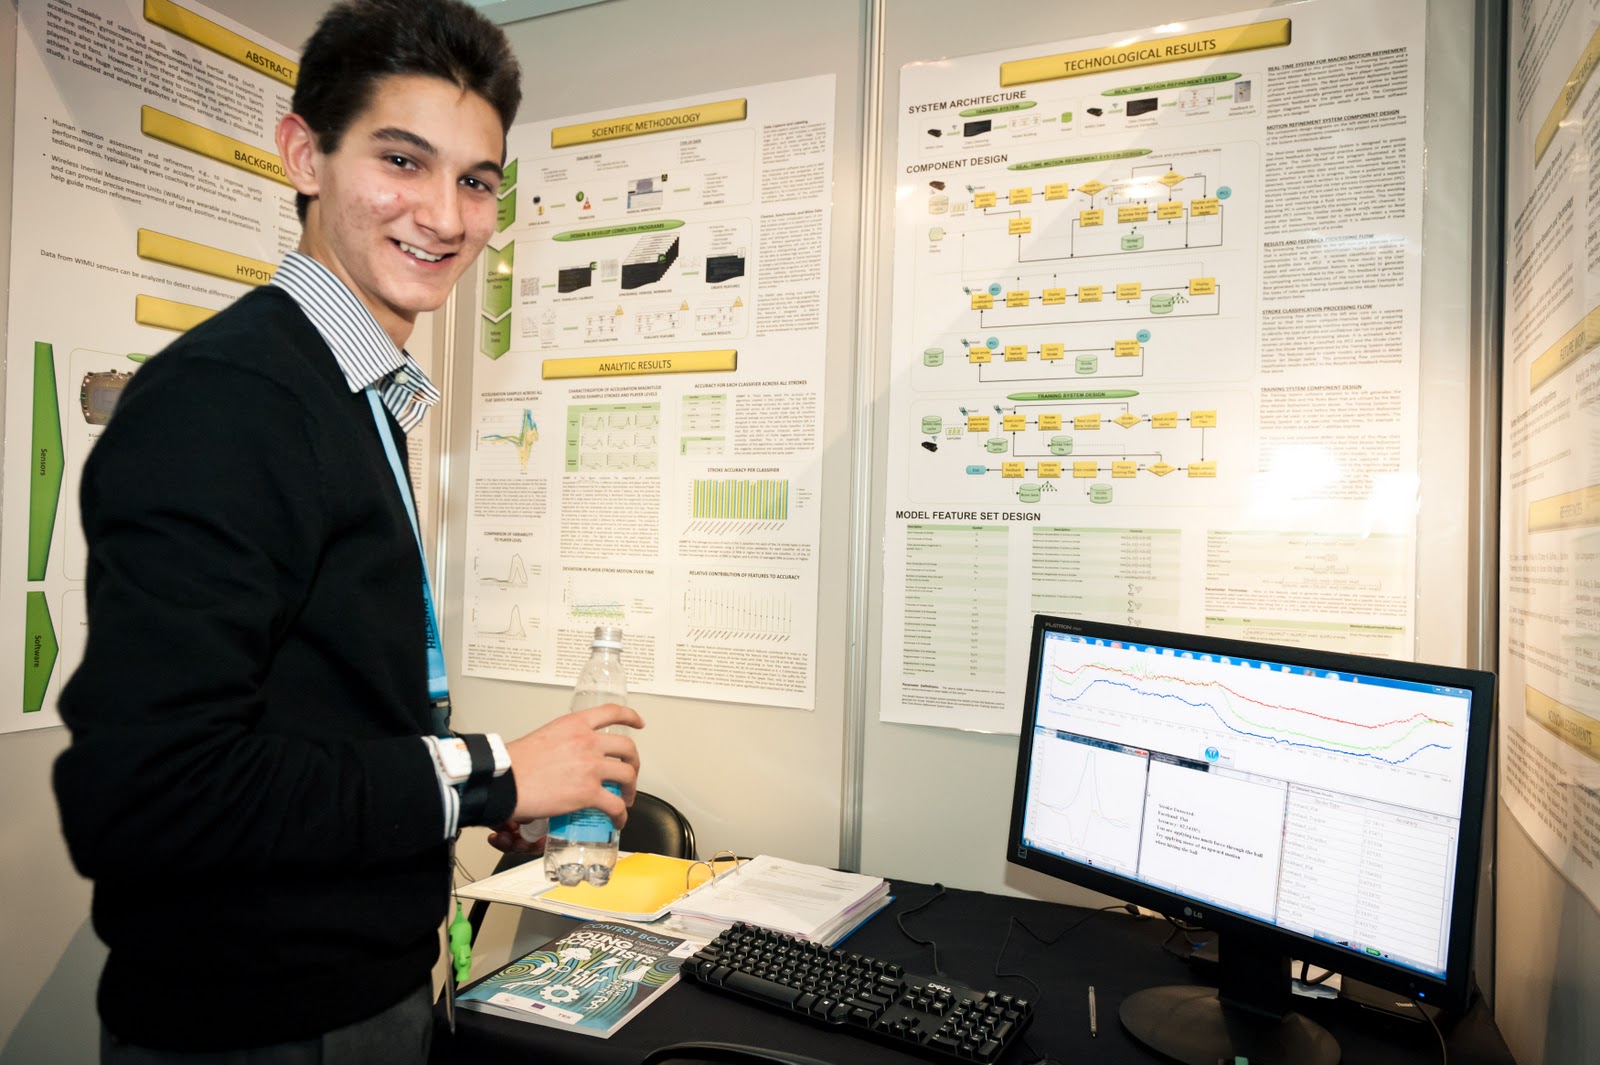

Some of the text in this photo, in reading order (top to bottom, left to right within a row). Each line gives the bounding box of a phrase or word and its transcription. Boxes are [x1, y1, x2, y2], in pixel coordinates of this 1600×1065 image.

[246, 50, 293, 80] ABSTRACT
[1064, 39, 1216, 72] TECHNOLOGICAL RESULTS
[1296, 59, 1315, 67] SYSTEM
[1327, 55, 1348, 63] MACRO
[1349, 52, 1371, 60] MOTION
[1372, 47, 1406, 57] REFINEMENT
[909, 91, 1026, 114] SYSTEM ARCHITECTURE
[592, 113, 700, 137] SCIENTIFIC METHODOLOGY
[1289, 119, 1321, 127] REFINEMENT
[1322, 116, 1342, 124] SYSTEM
[1344, 112, 1378, 121] COMPONENT
[52, 128, 93, 148] performance
[106, 146, 140, 162] rehabilitate
[143, 158, 161, 169] stroke
[172, 167, 195, 180] accident
[197, 175, 217, 188] victims,
[232, 186, 251, 198] difficult
[252, 193, 262, 201] and
[235, 150, 286, 177] BACKGROU
[906, 154, 1007, 174] COMPONENT DESIGN
[50, 174, 65, 184] help
[66, 178, 84, 190] guide
[85, 183, 108, 195] motion
[51, 155, 79, 169] Wireless
[80, 164, 103, 176] Inertial
[104, 171, 145, 189] Measurement
[147, 184, 162, 194] Units
[163, 189, 185, 203] (WIMU)
[196, 199, 220, 212] wearable
[221, 207, 231, 215] and
[51, 165, 64, 174] and
[77, 172, 101, 186] provide
[102, 180, 124, 193] precise
[125, 186, 168, 204] measurements
[175, 201, 193, 213] speed,
[194, 206, 216, 220] position,
[217, 213, 227, 221] and
[228, 216, 255, 229] orientation
[40, 249, 56, 258] Data
[57, 253, 73, 262] from
[74, 257, 95, 267] WIMU
[96, 263, 119, 272] sensors
[140, 272, 165, 285] analyzed
[173, 280, 190, 289] detect
[191, 284, 207, 293] subtle
[208, 288, 236, 299] differences
[237, 265, 271, 282] HYPOT
[599, 359, 671, 372] ANALYTIC RESULTS
[896, 511, 1041, 521] MODEL FEATURE SET DESIGN
[1045, 622, 1072, 630] FLATRON
[34, 635, 42, 668] Software
[566, 932, 633, 950] YOUNG
[583, 923, 679, 947] CONTEST BOOK
[555, 937, 657, 964] SCIENTISTS
[928, 983, 951, 993] DELL
